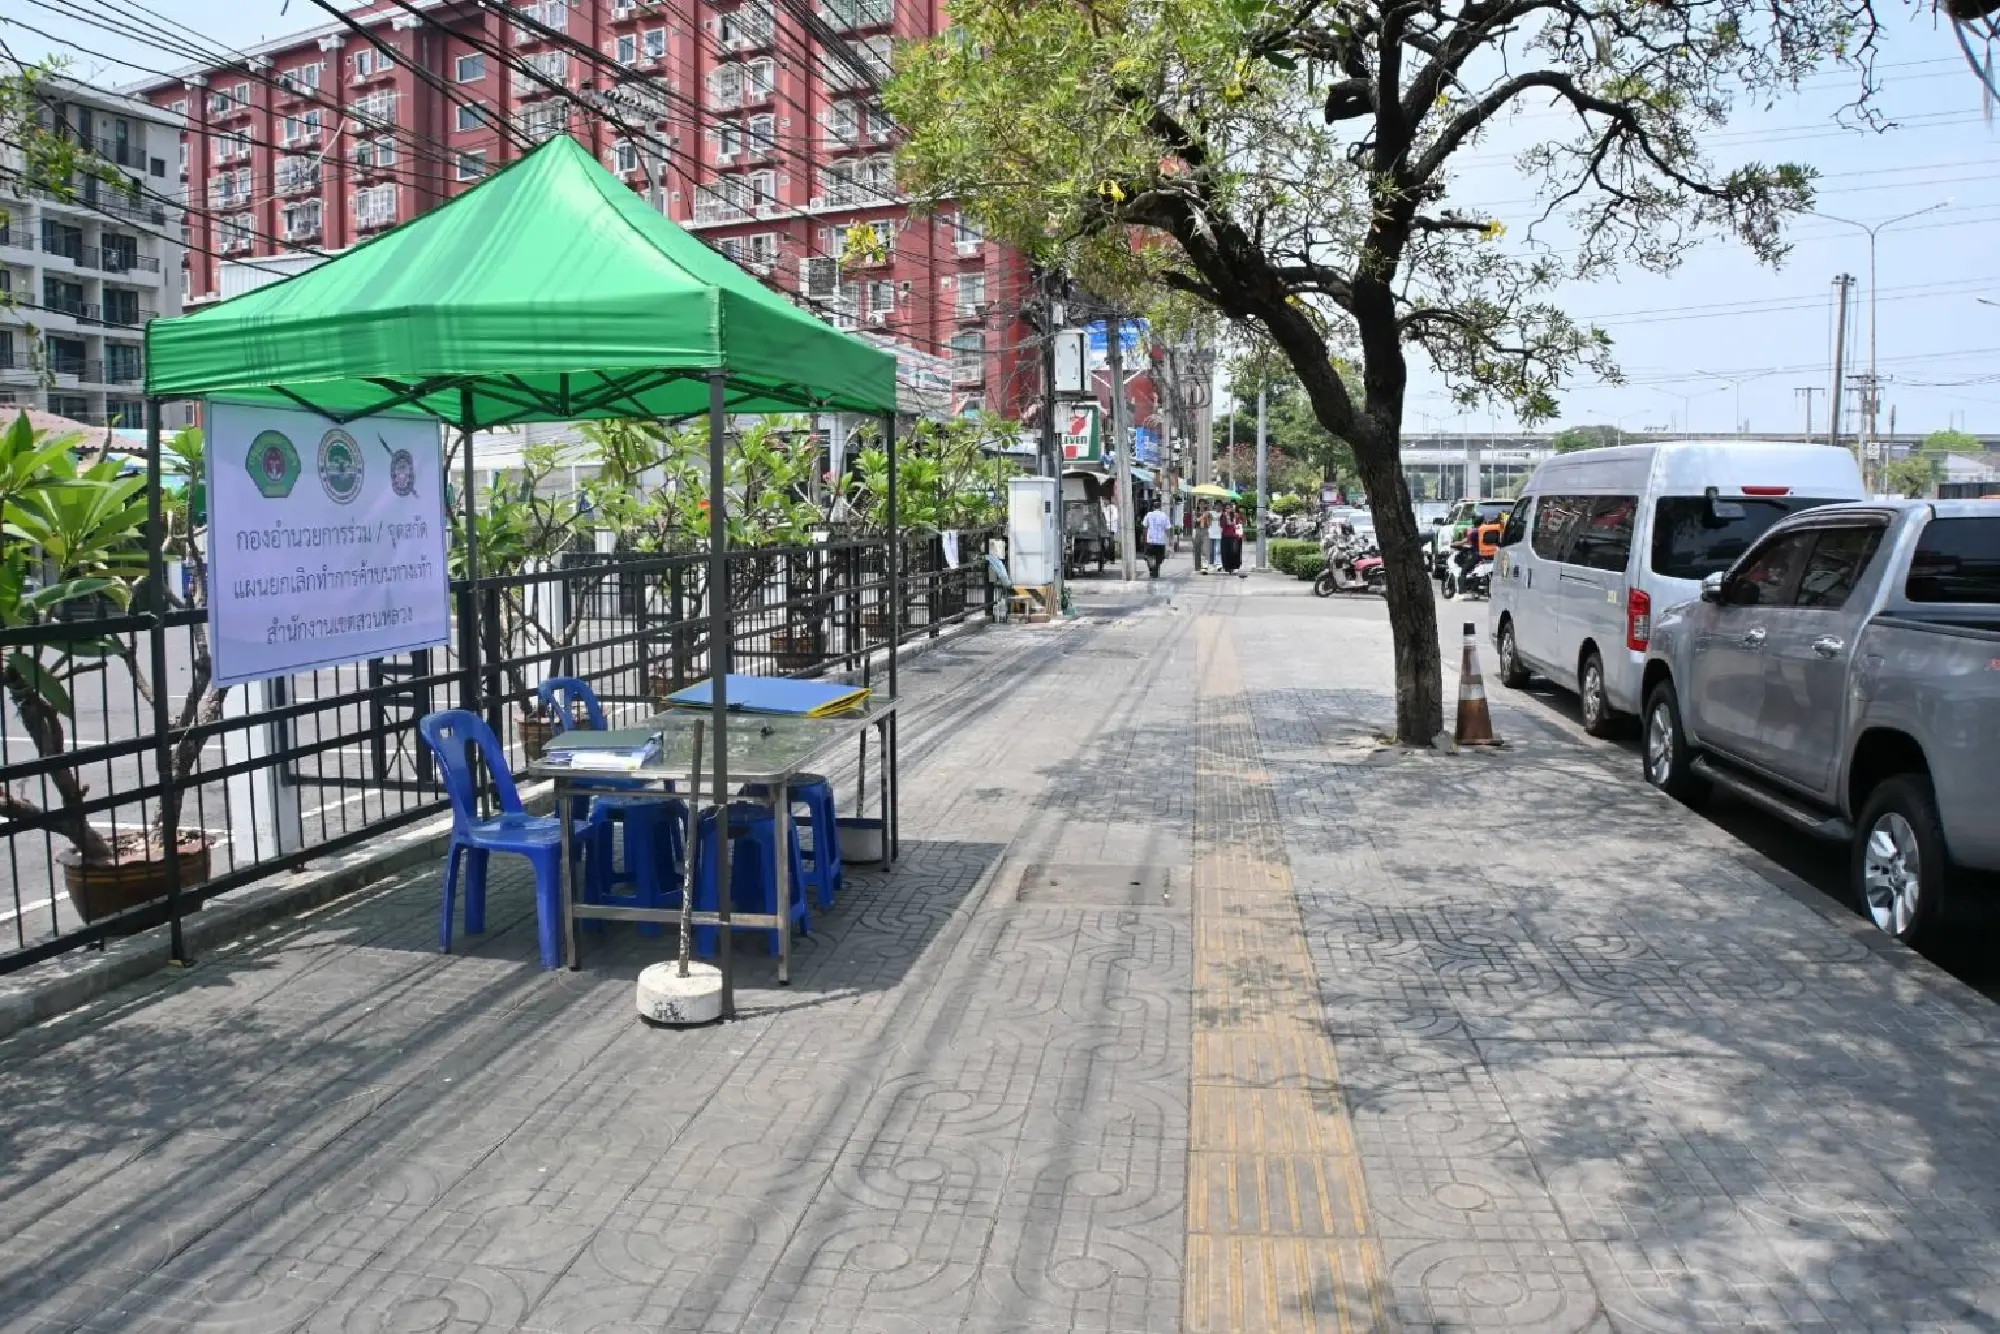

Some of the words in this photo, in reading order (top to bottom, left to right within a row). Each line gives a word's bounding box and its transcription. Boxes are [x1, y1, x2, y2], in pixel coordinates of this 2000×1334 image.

[236, 517, 372, 551] กองอำนวยการร่วม
[233, 554, 433, 600] แผนยกเลิกทำการค้าบนทางเท้า
[266, 606, 414, 645] สำนักงานเขตสวนหลวง
